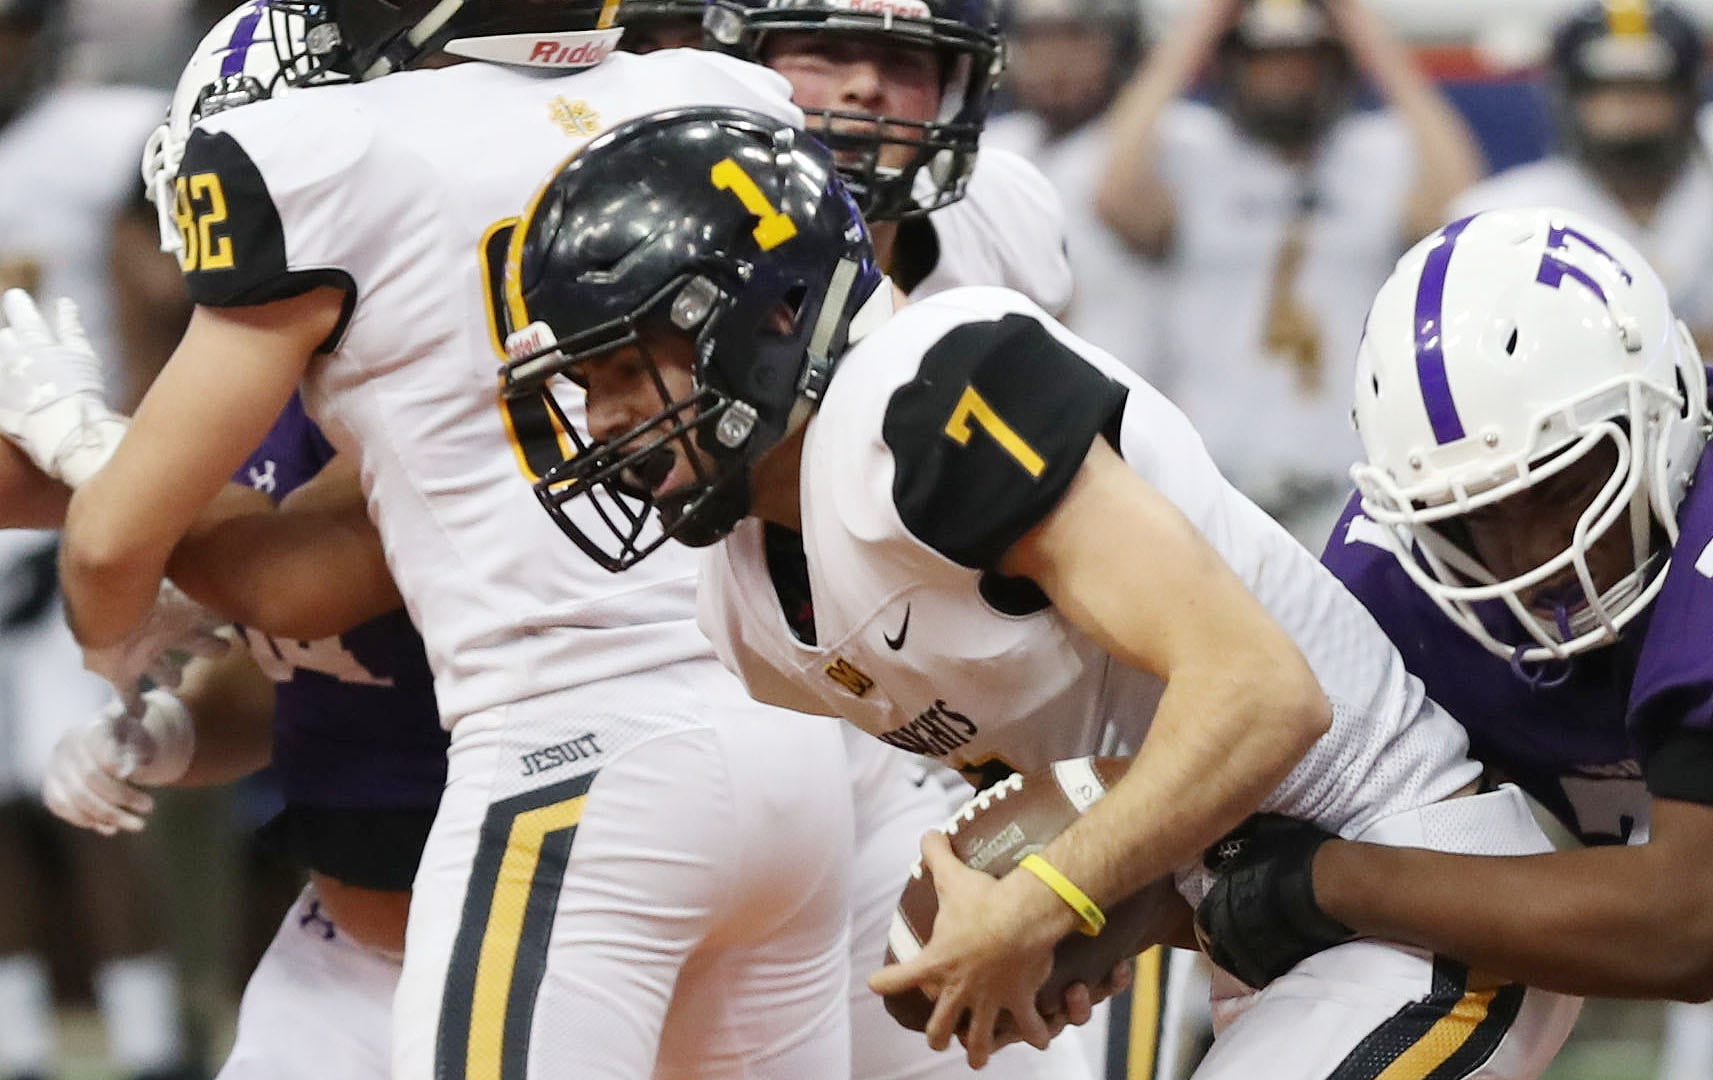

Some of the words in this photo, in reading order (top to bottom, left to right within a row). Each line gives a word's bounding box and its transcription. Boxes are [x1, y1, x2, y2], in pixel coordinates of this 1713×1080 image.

[711, 157, 799, 251] 1
[945, 384, 1048, 478] 7
[521, 732, 602, 776] JESUIT
